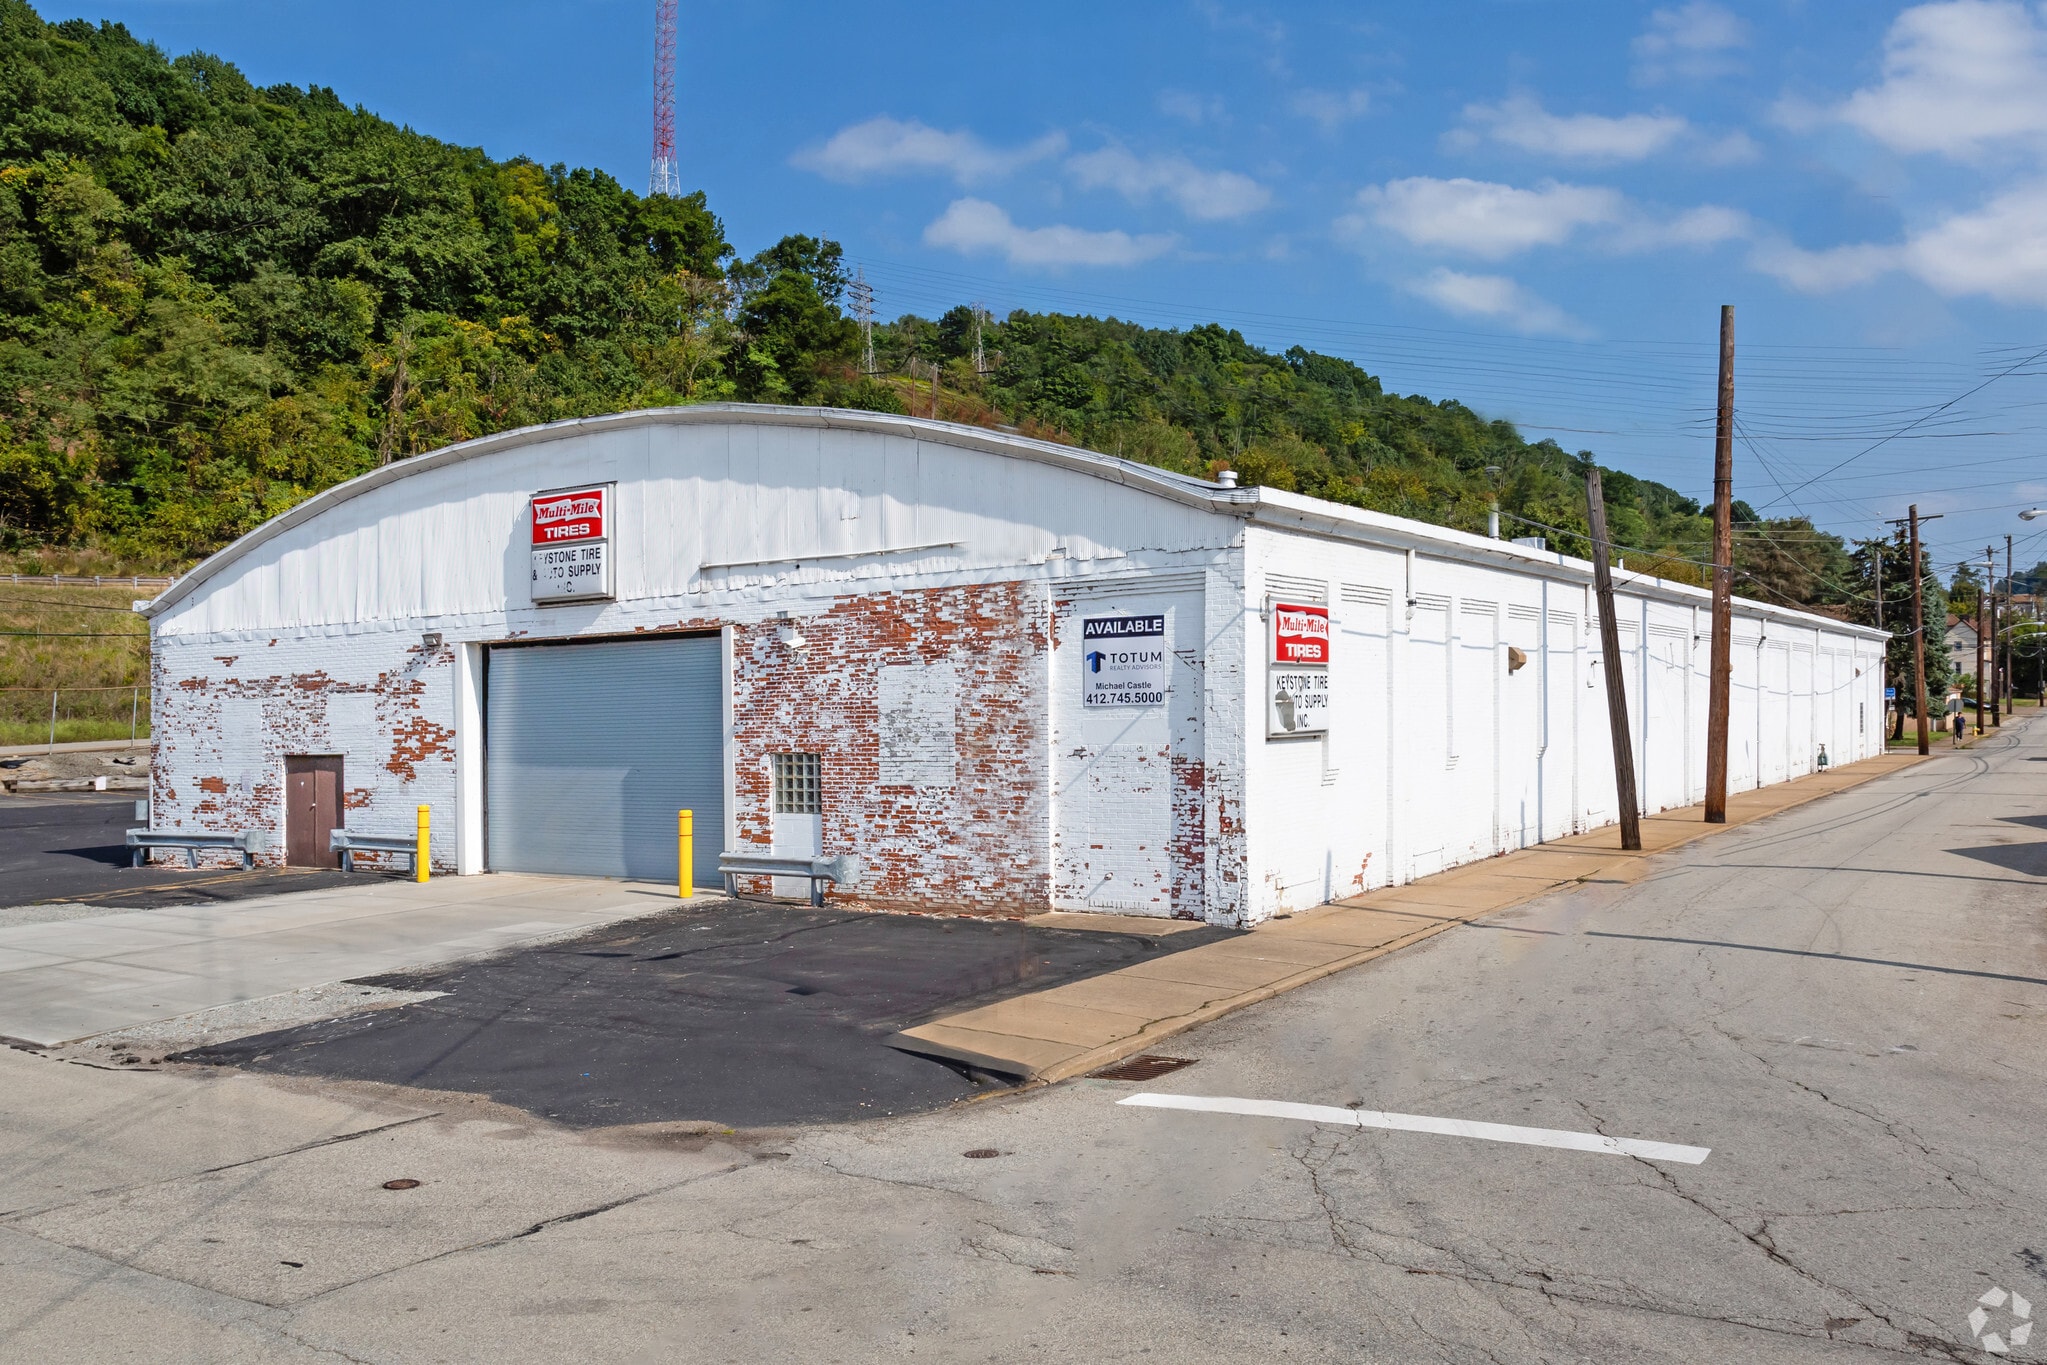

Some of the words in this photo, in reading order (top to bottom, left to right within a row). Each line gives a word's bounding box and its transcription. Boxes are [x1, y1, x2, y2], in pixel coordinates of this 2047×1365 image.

[539, 502, 594, 519] Multi-Mile
[544, 523, 590, 539] TIRES
[534, 550, 577, 564] YSTONE
[581, 547, 601, 561] TIRE
[532, 569, 538, 581] &
[568, 563, 601, 578] SUPPLY
[1085, 619, 1163, 635] AVAILABLE
[1282, 616, 1325, 633] Multi-Mile
[1110, 651, 1162, 664] TOTUM
[1285, 643, 1322, 659] TIRES
[1109, 664, 1130, 672] REALTY
[1131, 663, 1162, 671] ADVISORS
[1095, 682, 1125, 690] Michael
[1127, 681, 1152, 690] Castle
[1314, 675, 1328, 690] TIRE
[1086, 691, 1163, 704] 412.745.5000
[1305, 694, 1329, 709] SUPPLY
[1296, 713, 1311, 728] INC.
